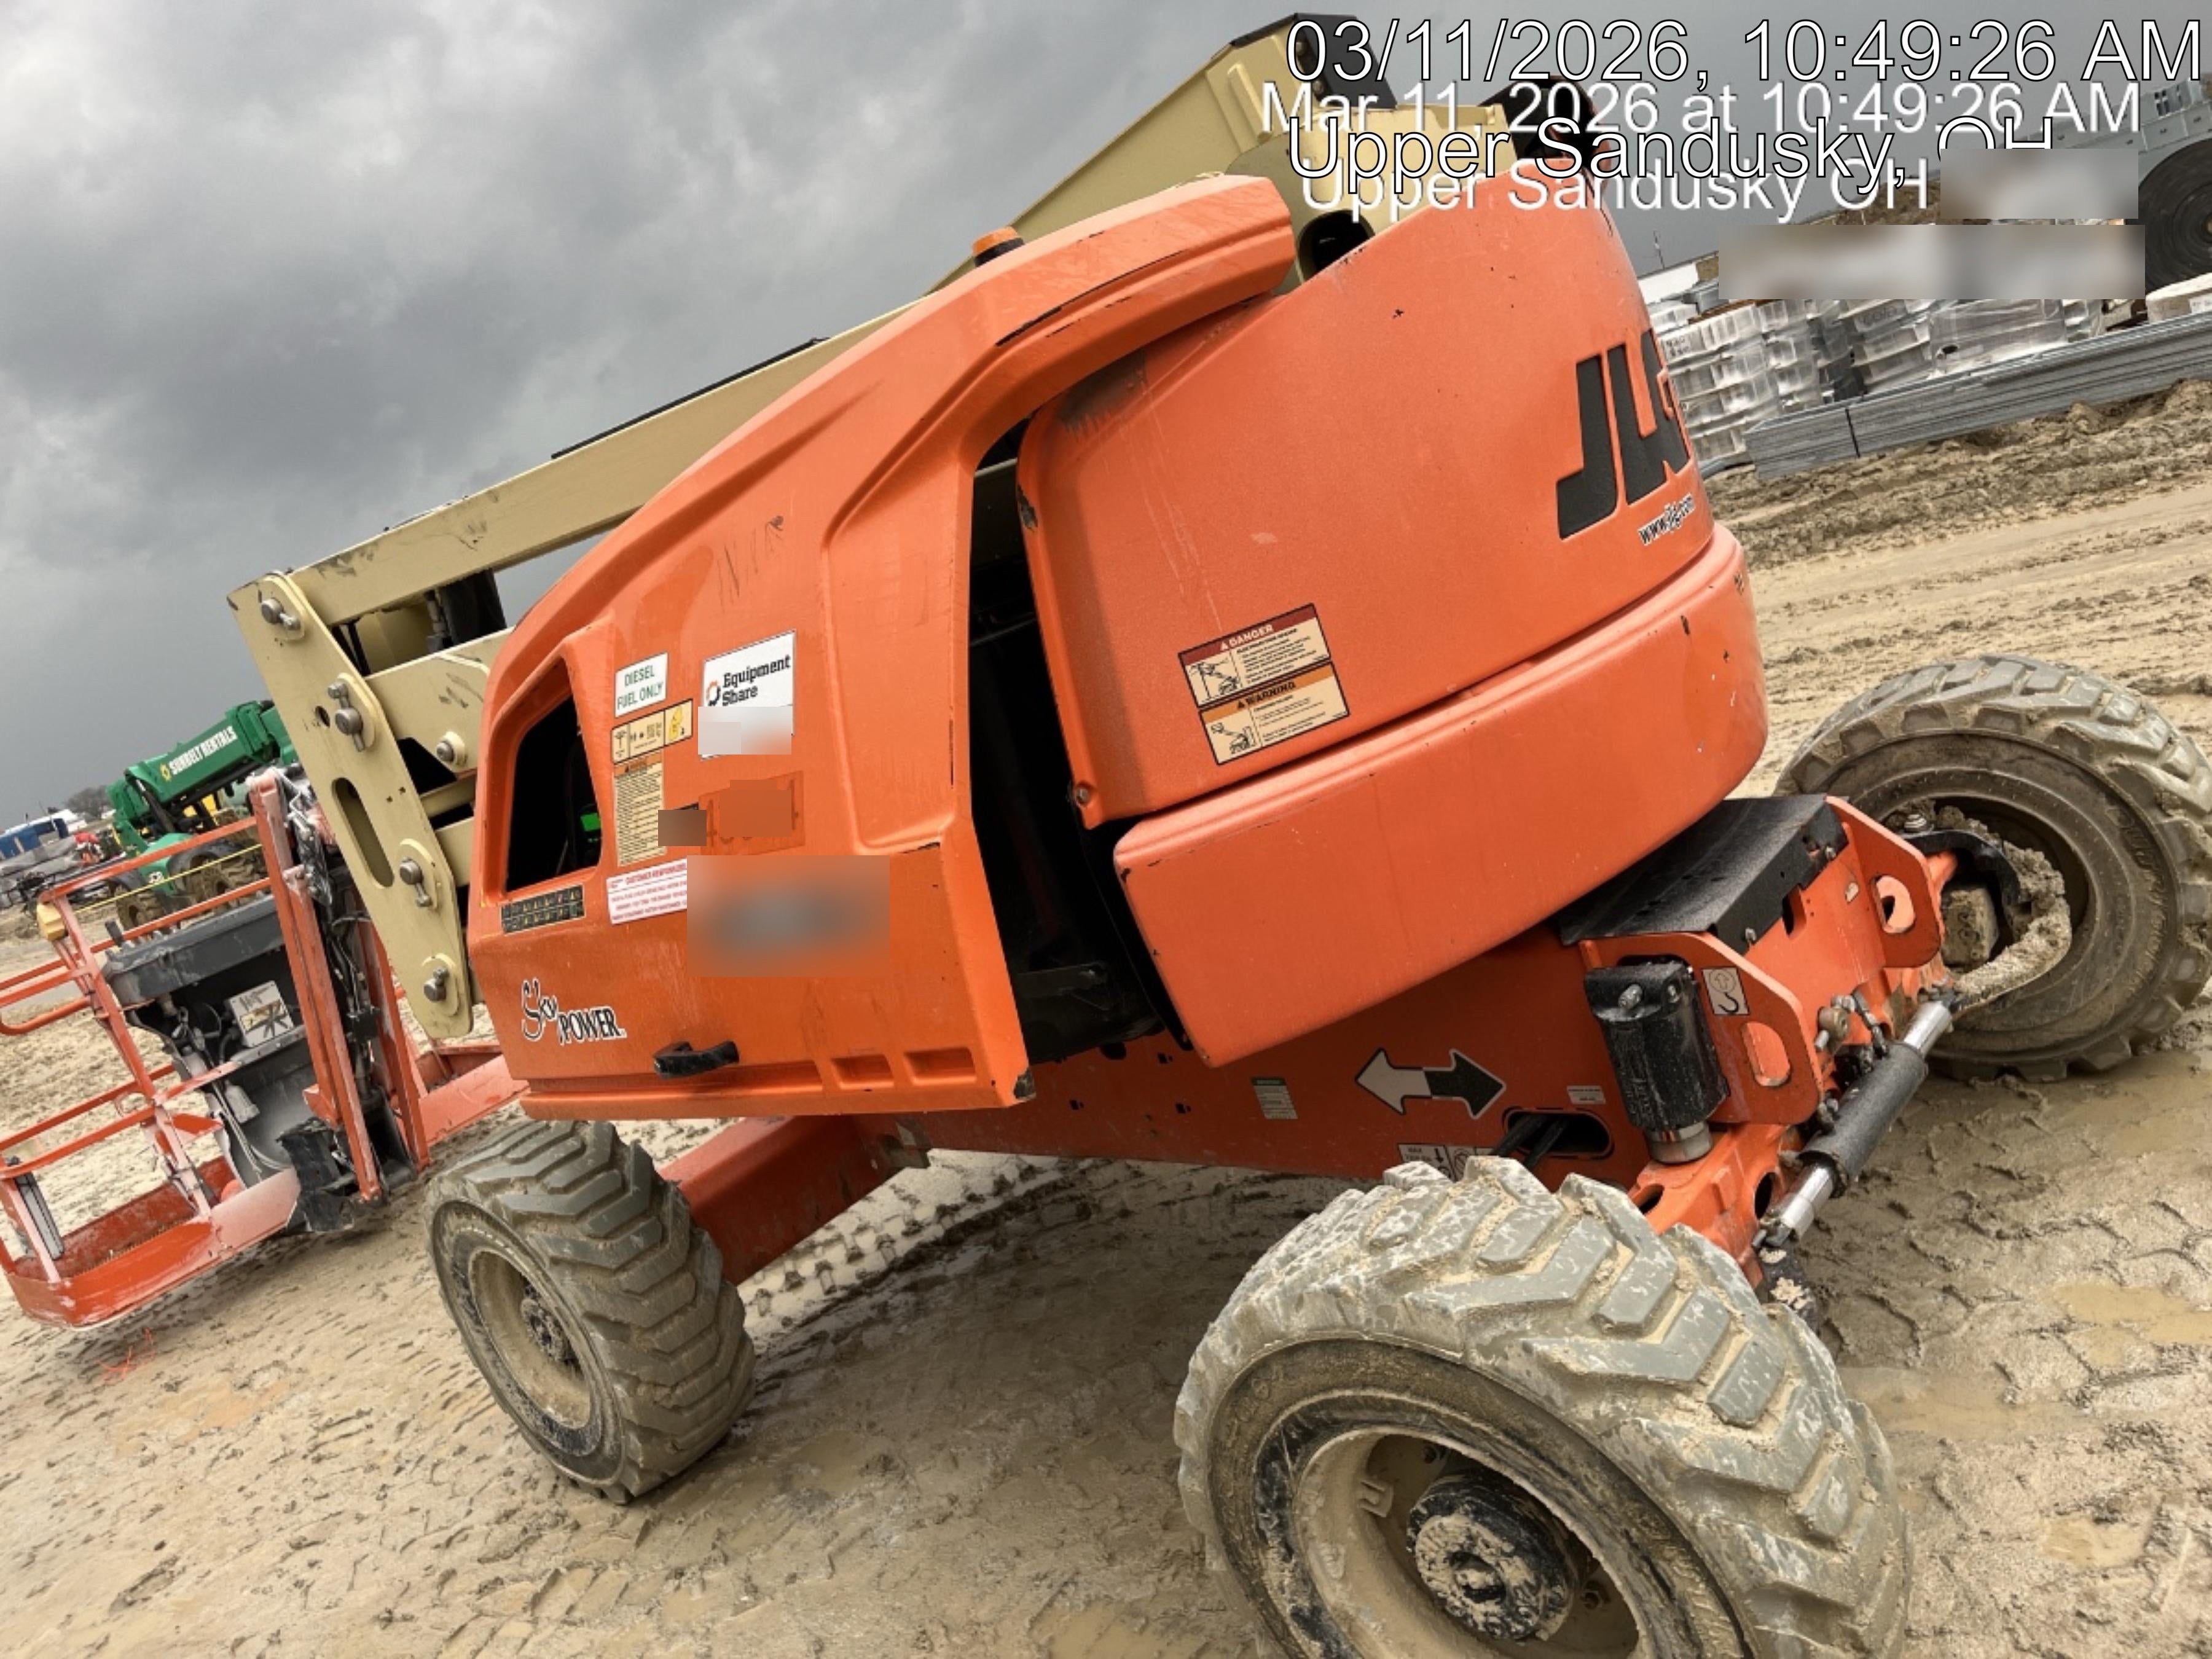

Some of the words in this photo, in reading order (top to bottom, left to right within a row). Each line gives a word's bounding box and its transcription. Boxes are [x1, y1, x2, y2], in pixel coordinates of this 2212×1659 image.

[1229, 624, 1273, 648] DANGER
[624, 665, 656, 686] DIESEL
[723, 654, 791, 688] Equipment
[617, 694, 637, 710] FUEL
[639, 681, 664, 702] ONLY
[722, 684, 758, 707] Share
